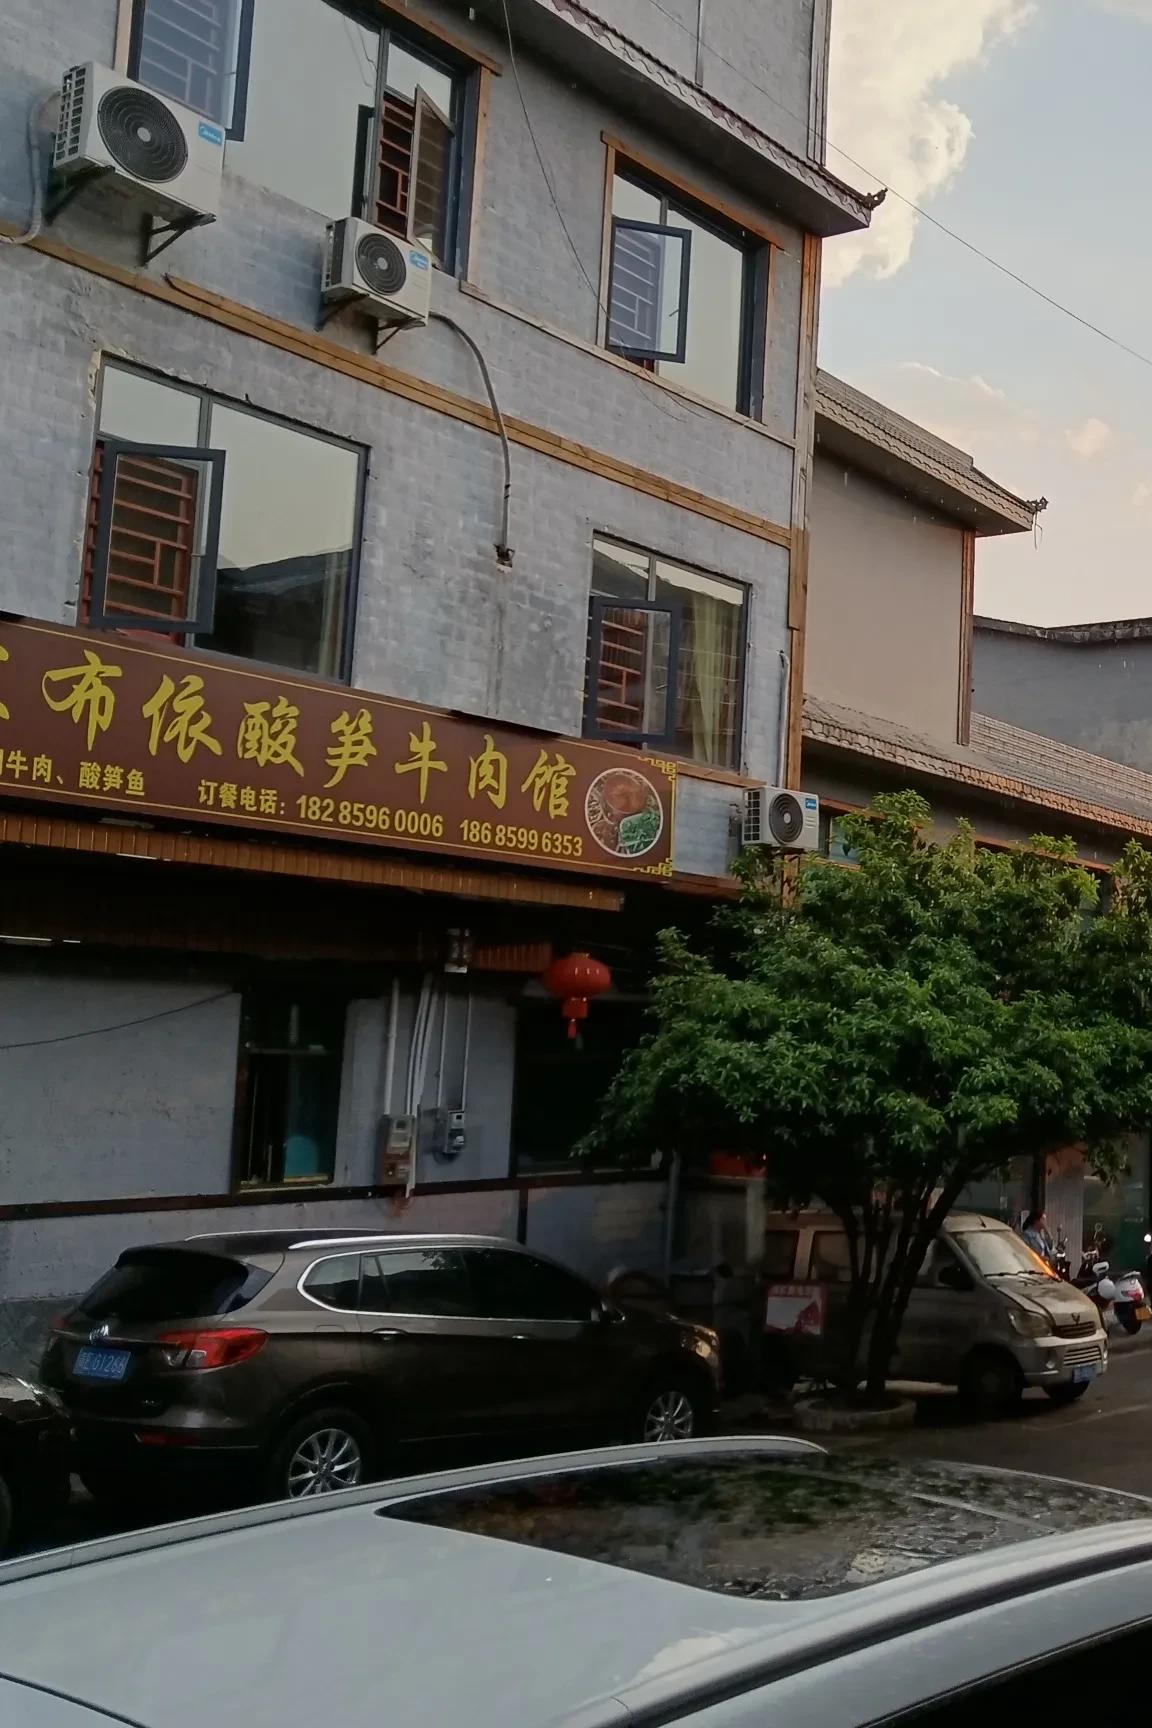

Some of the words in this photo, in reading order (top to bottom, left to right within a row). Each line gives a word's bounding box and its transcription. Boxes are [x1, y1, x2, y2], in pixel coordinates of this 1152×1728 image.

[0, 646, 576, 819] 布依酸笋牛肉馆
[0, 749, 145, 796] 牛肉、酸笋鱼
